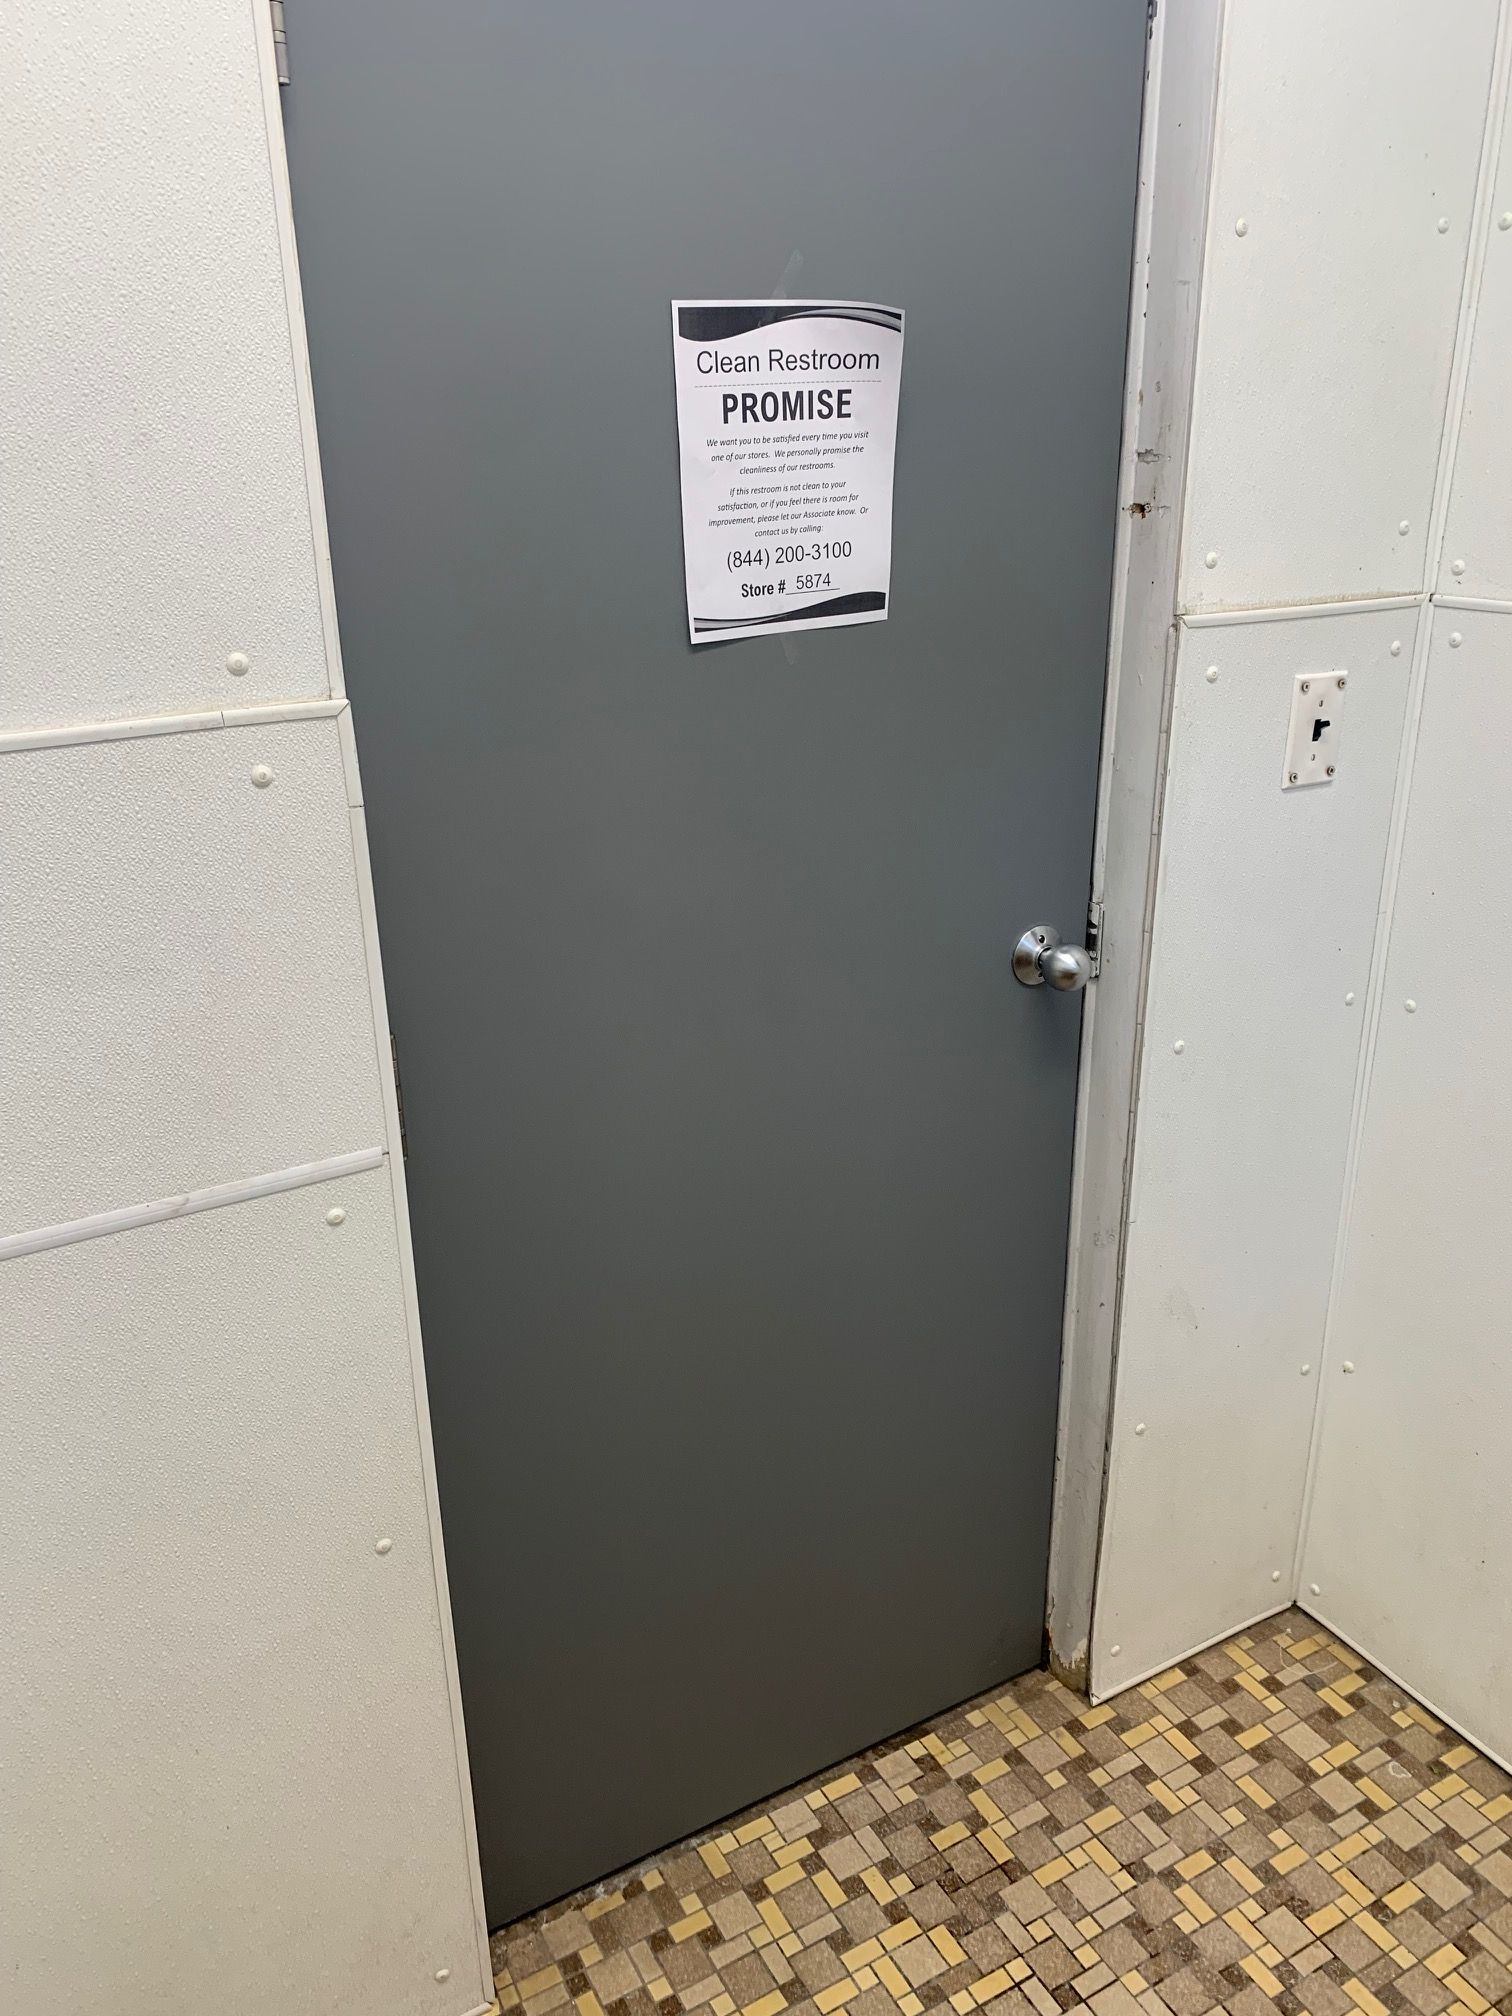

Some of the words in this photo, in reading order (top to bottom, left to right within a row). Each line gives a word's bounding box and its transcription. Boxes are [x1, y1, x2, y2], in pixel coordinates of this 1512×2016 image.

[697, 350, 760, 374] Clean
[769, 349, 880, 372] Restroom
[722, 389, 852, 424] PROMISE
[706, 439, 718, 447] We
[720, 438, 738, 446] want
[739, 438, 752, 446] you
[772, 435, 800, 444] satisfied
[801, 434, 820, 442] every
[822, 432, 837, 440] time
[726, 453, 733, 462] of
[748, 451, 770, 459] stores.
[786, 447, 821, 458] personally
[822, 447, 851, 455] promise
[739, 466, 777, 475] cleanliness
[778, 465, 785, 473] of
[799, 462, 835, 470] restrooms.
[736, 488, 749, 496] this
[751, 485, 781, 494] restroom
[830, 481, 846, 489] your
[717, 502, 759, 512] satisfaction,
[769, 499, 776, 508] if
[775, 500, 788, 508] you
[789, 497, 802, 506] feel
[803, 496, 821, 505] there
[848, 494, 859, 502] for
[708, 517, 756, 527] improvement,
[757, 515, 779, 524] please
[781, 513, 789, 521] let
[803, 510, 835, 519] Associate
[837, 508, 857, 516] know.
[754, 529, 779, 537] contact
[790, 526, 798, 534] by
[799, 525, 824, 533] calling:
[727, 548, 770, 573] (844)
[775, 541, 852, 564] 200-3100
[741, 583, 774, 598] Store
[778, 579, 786, 593] #
[796, 573, 831, 590] 5874
